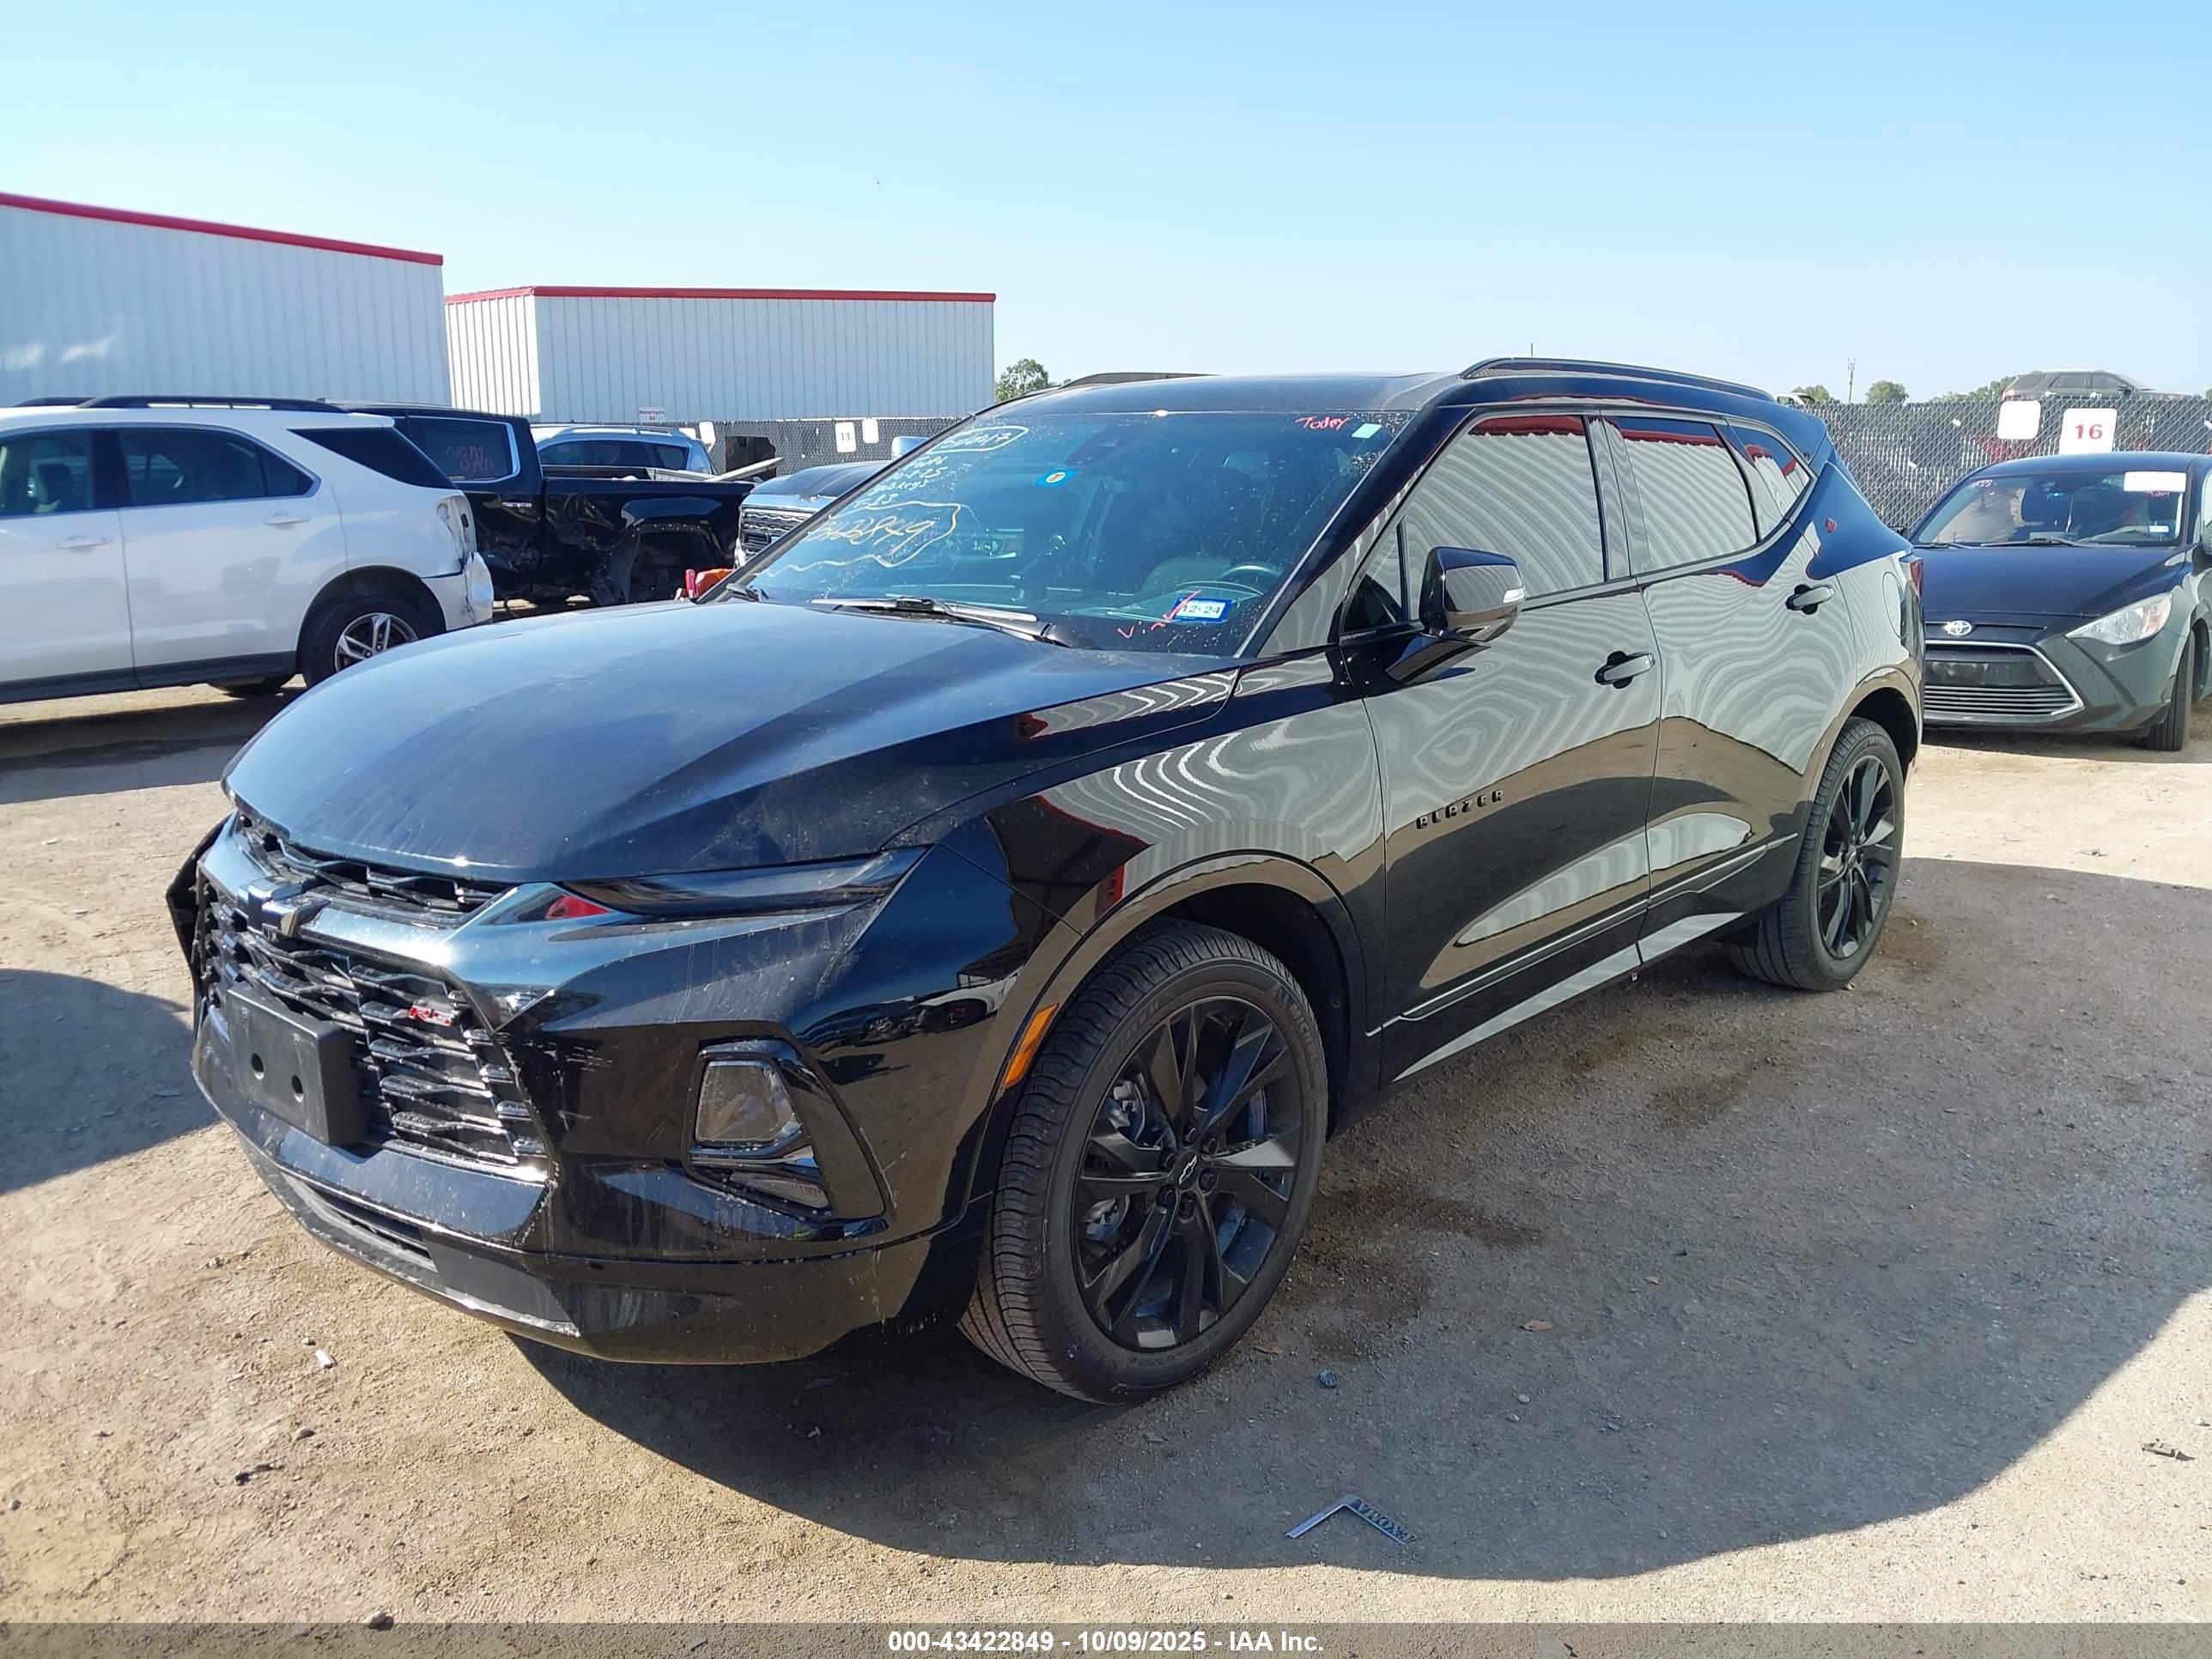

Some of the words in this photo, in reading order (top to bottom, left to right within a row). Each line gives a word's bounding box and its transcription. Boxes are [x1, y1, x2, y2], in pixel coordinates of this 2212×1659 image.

[841, 431, 850, 441] 11
[2075, 423, 2103, 440] 16
[1416, 789, 1503, 830] BLAZER
[408, 1005, 452, 1027] RS
